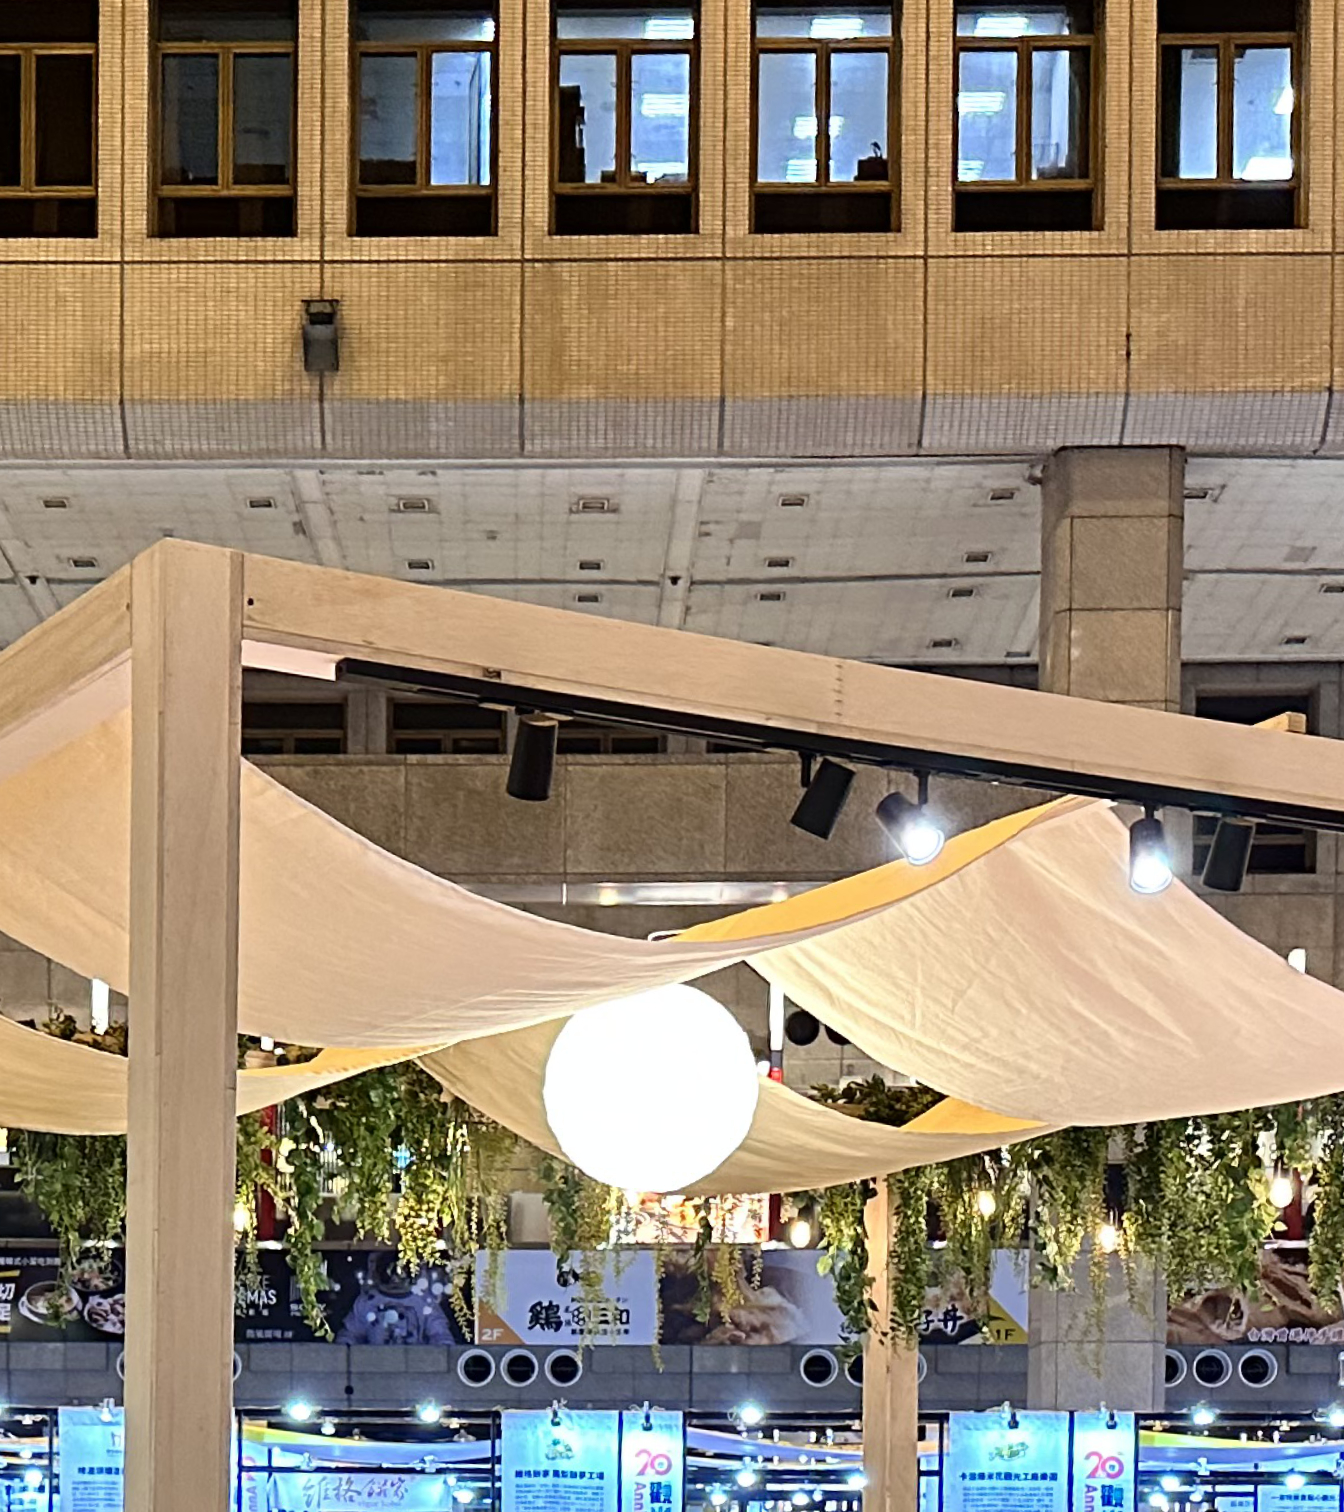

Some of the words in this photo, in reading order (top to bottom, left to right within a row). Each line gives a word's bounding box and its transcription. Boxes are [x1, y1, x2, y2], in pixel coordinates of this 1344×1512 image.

[481, 1328, 504, 1341] 2F
[995, 1328, 1016, 1341] 1F
[1084, 1451, 1125, 1480] 20
